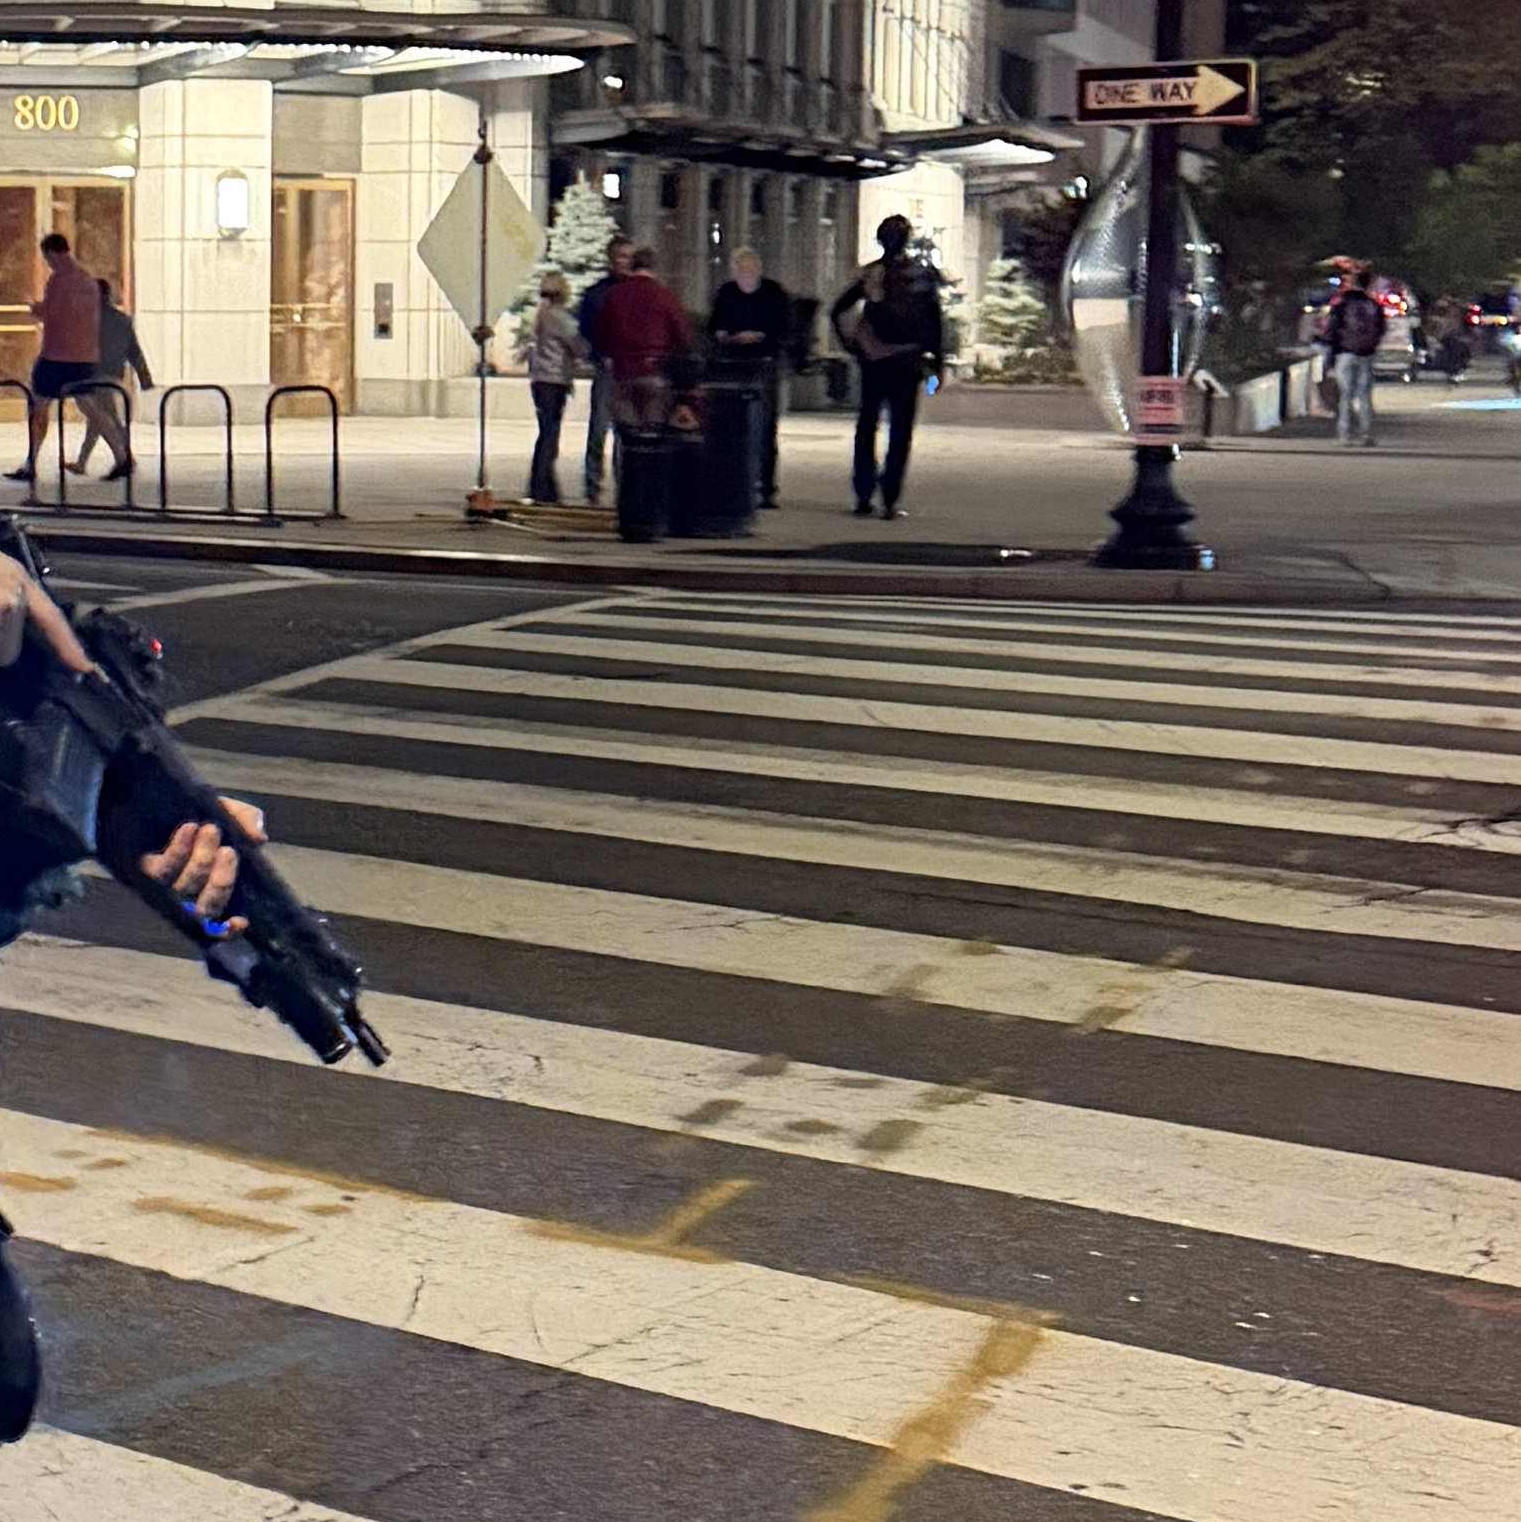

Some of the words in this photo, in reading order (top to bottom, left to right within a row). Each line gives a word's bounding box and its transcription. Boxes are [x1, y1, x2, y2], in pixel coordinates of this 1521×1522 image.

[1095, 83, 1140, 105] ONE
[1149, 80, 1197, 102] WAY
[14, 94, 79, 131] 800
